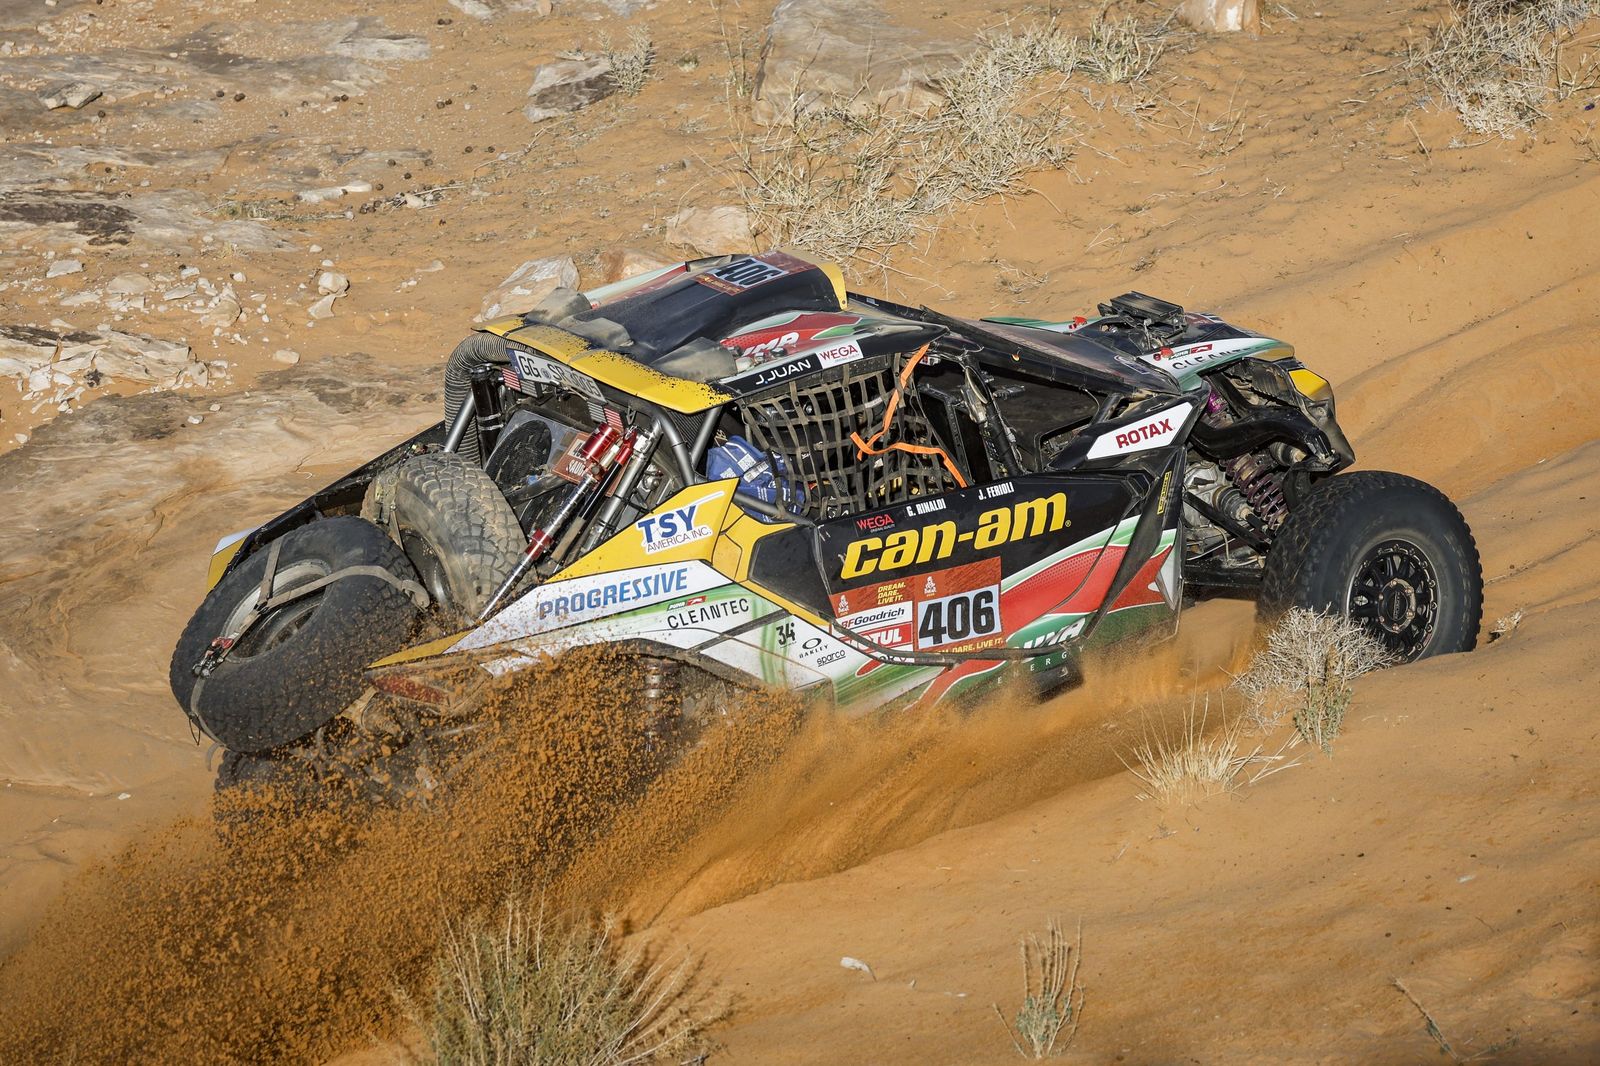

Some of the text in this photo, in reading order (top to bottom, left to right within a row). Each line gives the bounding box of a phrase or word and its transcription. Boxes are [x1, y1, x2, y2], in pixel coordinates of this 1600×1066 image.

[819, 344, 858, 361] WEGA
[518, 355, 541, 378] GG
[755, 359, 812, 385] J.JUAN
[1115, 418, 1174, 448] ROTAX
[986, 482, 1015, 499] FERIOLI
[915, 498, 947, 515] RINALDI
[637, 505, 698, 543] TSY
[856, 514, 895, 530] WEGA
[646, 526, 712, 553] AMERICA INC.
[539, 567, 689, 620] PROGRESSIVE
[877, 581, 906, 593] DREAM.
[877, 589, 899, 599] DARE.
[877, 596, 894, 605] LIVE
[667, 598, 750, 629] CLEANTEC
[840, 607, 905, 629] BFGoodrich
[918, 590, 995, 645] 406
[799, 644, 829, 659] OAKLEY
[816, 649, 846, 666] sparco
